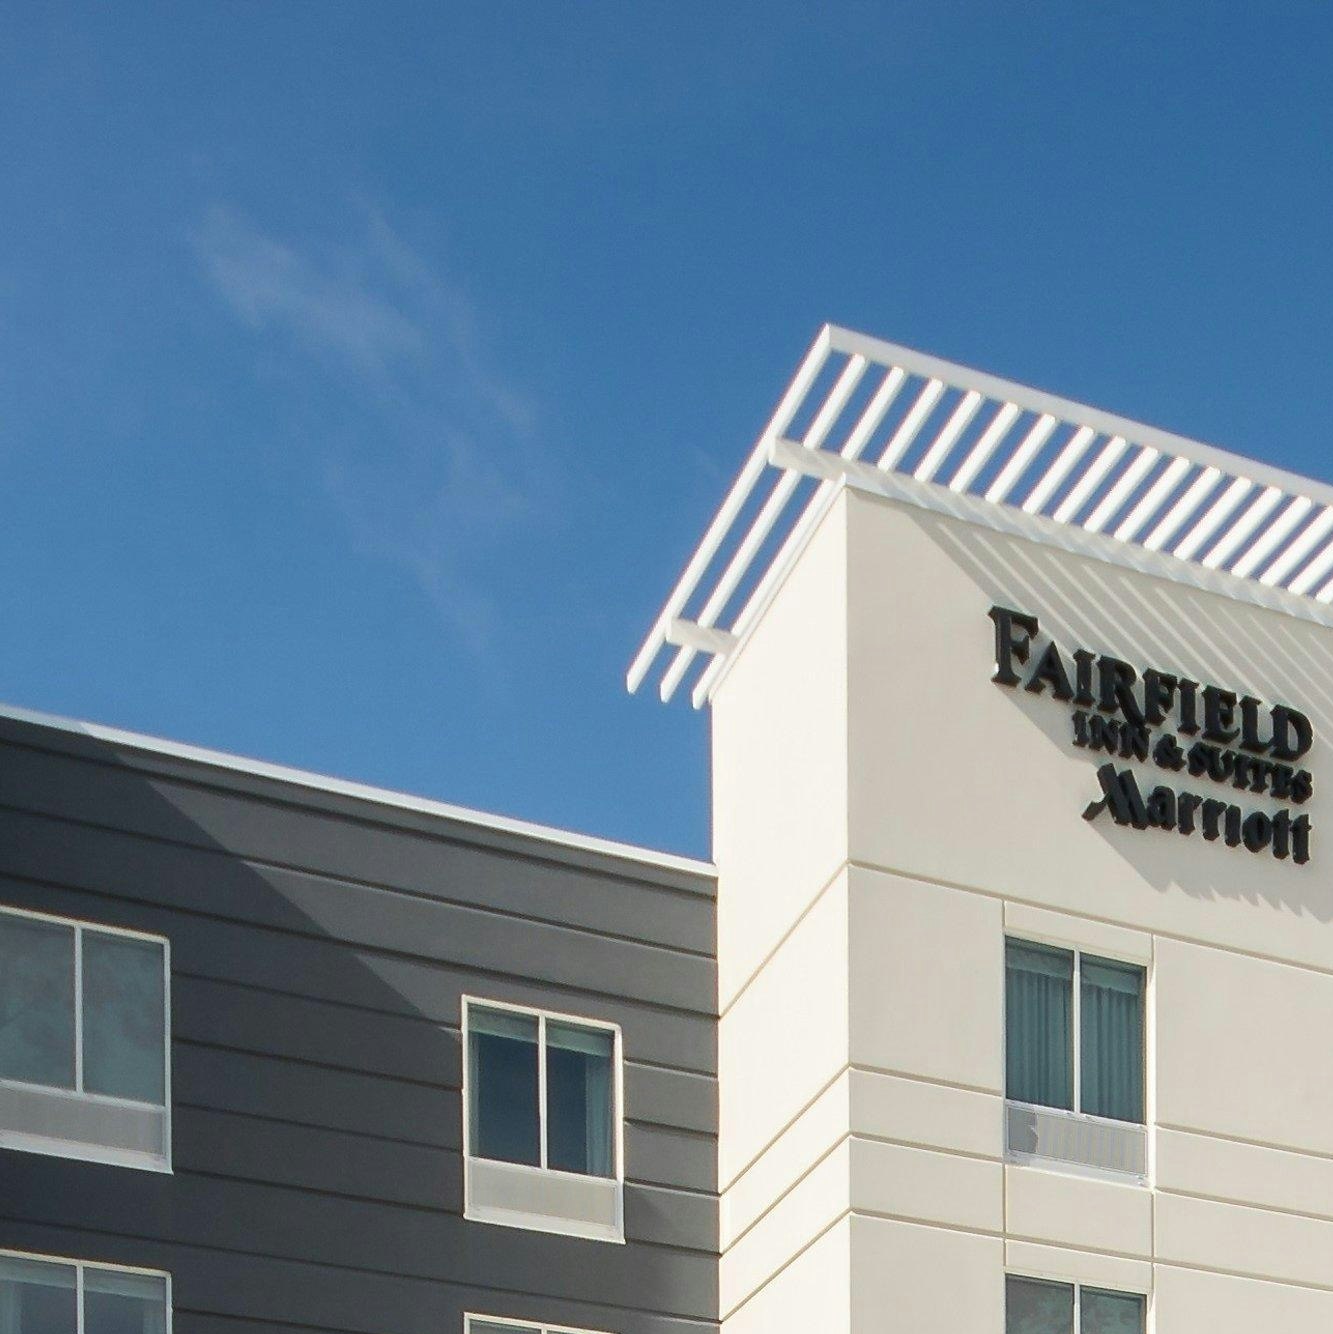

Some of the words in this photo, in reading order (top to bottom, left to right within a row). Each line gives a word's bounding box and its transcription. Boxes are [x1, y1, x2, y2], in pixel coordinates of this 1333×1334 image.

[988, 605, 1314, 762] FAIRFIELD
[1072, 710, 1150, 763] INN
[1153, 734, 1186, 772] &
[1187, 742, 1313, 804] SUITES
[1082, 763, 1312, 865] Marriott
